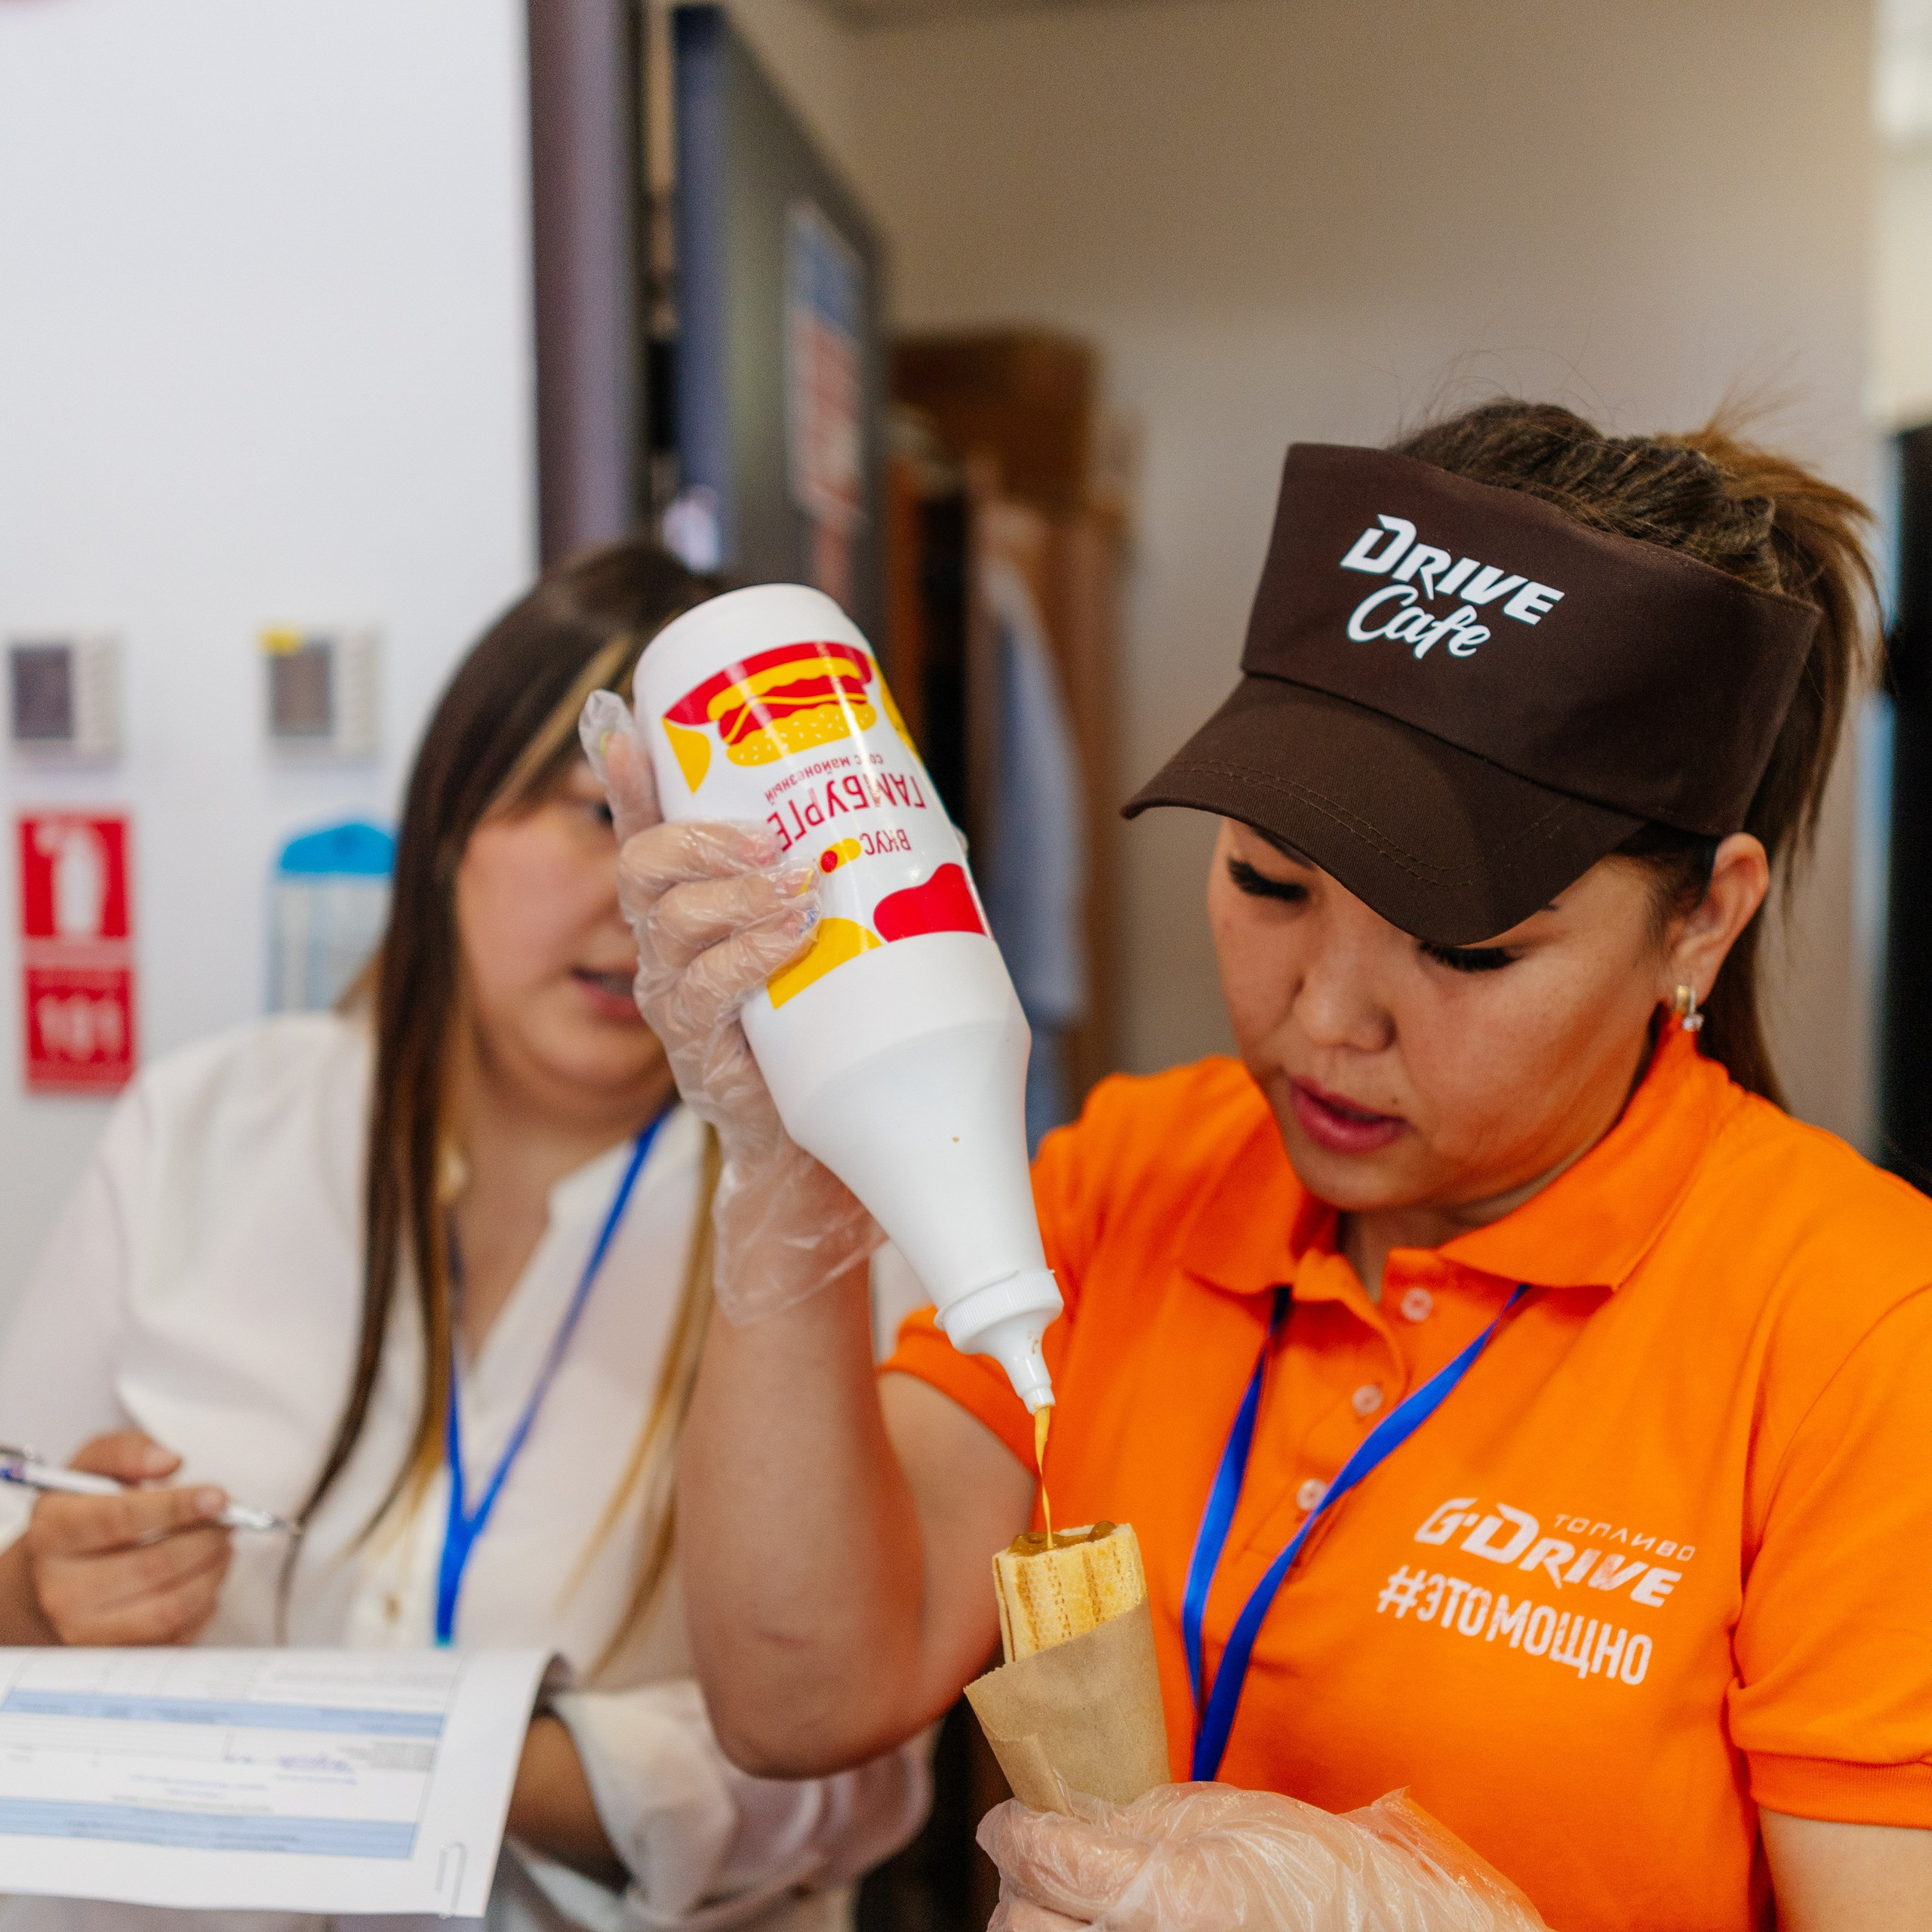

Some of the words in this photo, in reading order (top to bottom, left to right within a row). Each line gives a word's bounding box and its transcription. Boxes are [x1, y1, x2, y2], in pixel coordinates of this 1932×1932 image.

[1340, 514, 1565, 626] DRIVE
[1347, 584, 1492, 660] Cafe
[854, 753, 884, 766] сос
[765, 772, 928, 853] ГАМБУРГЕ
[860, 829, 912, 856] ВКУС
[1553, 1514, 1697, 1561] ТОПЛИВО
[1377, 1564, 1654, 1686] #ЭТОМОЩНО
